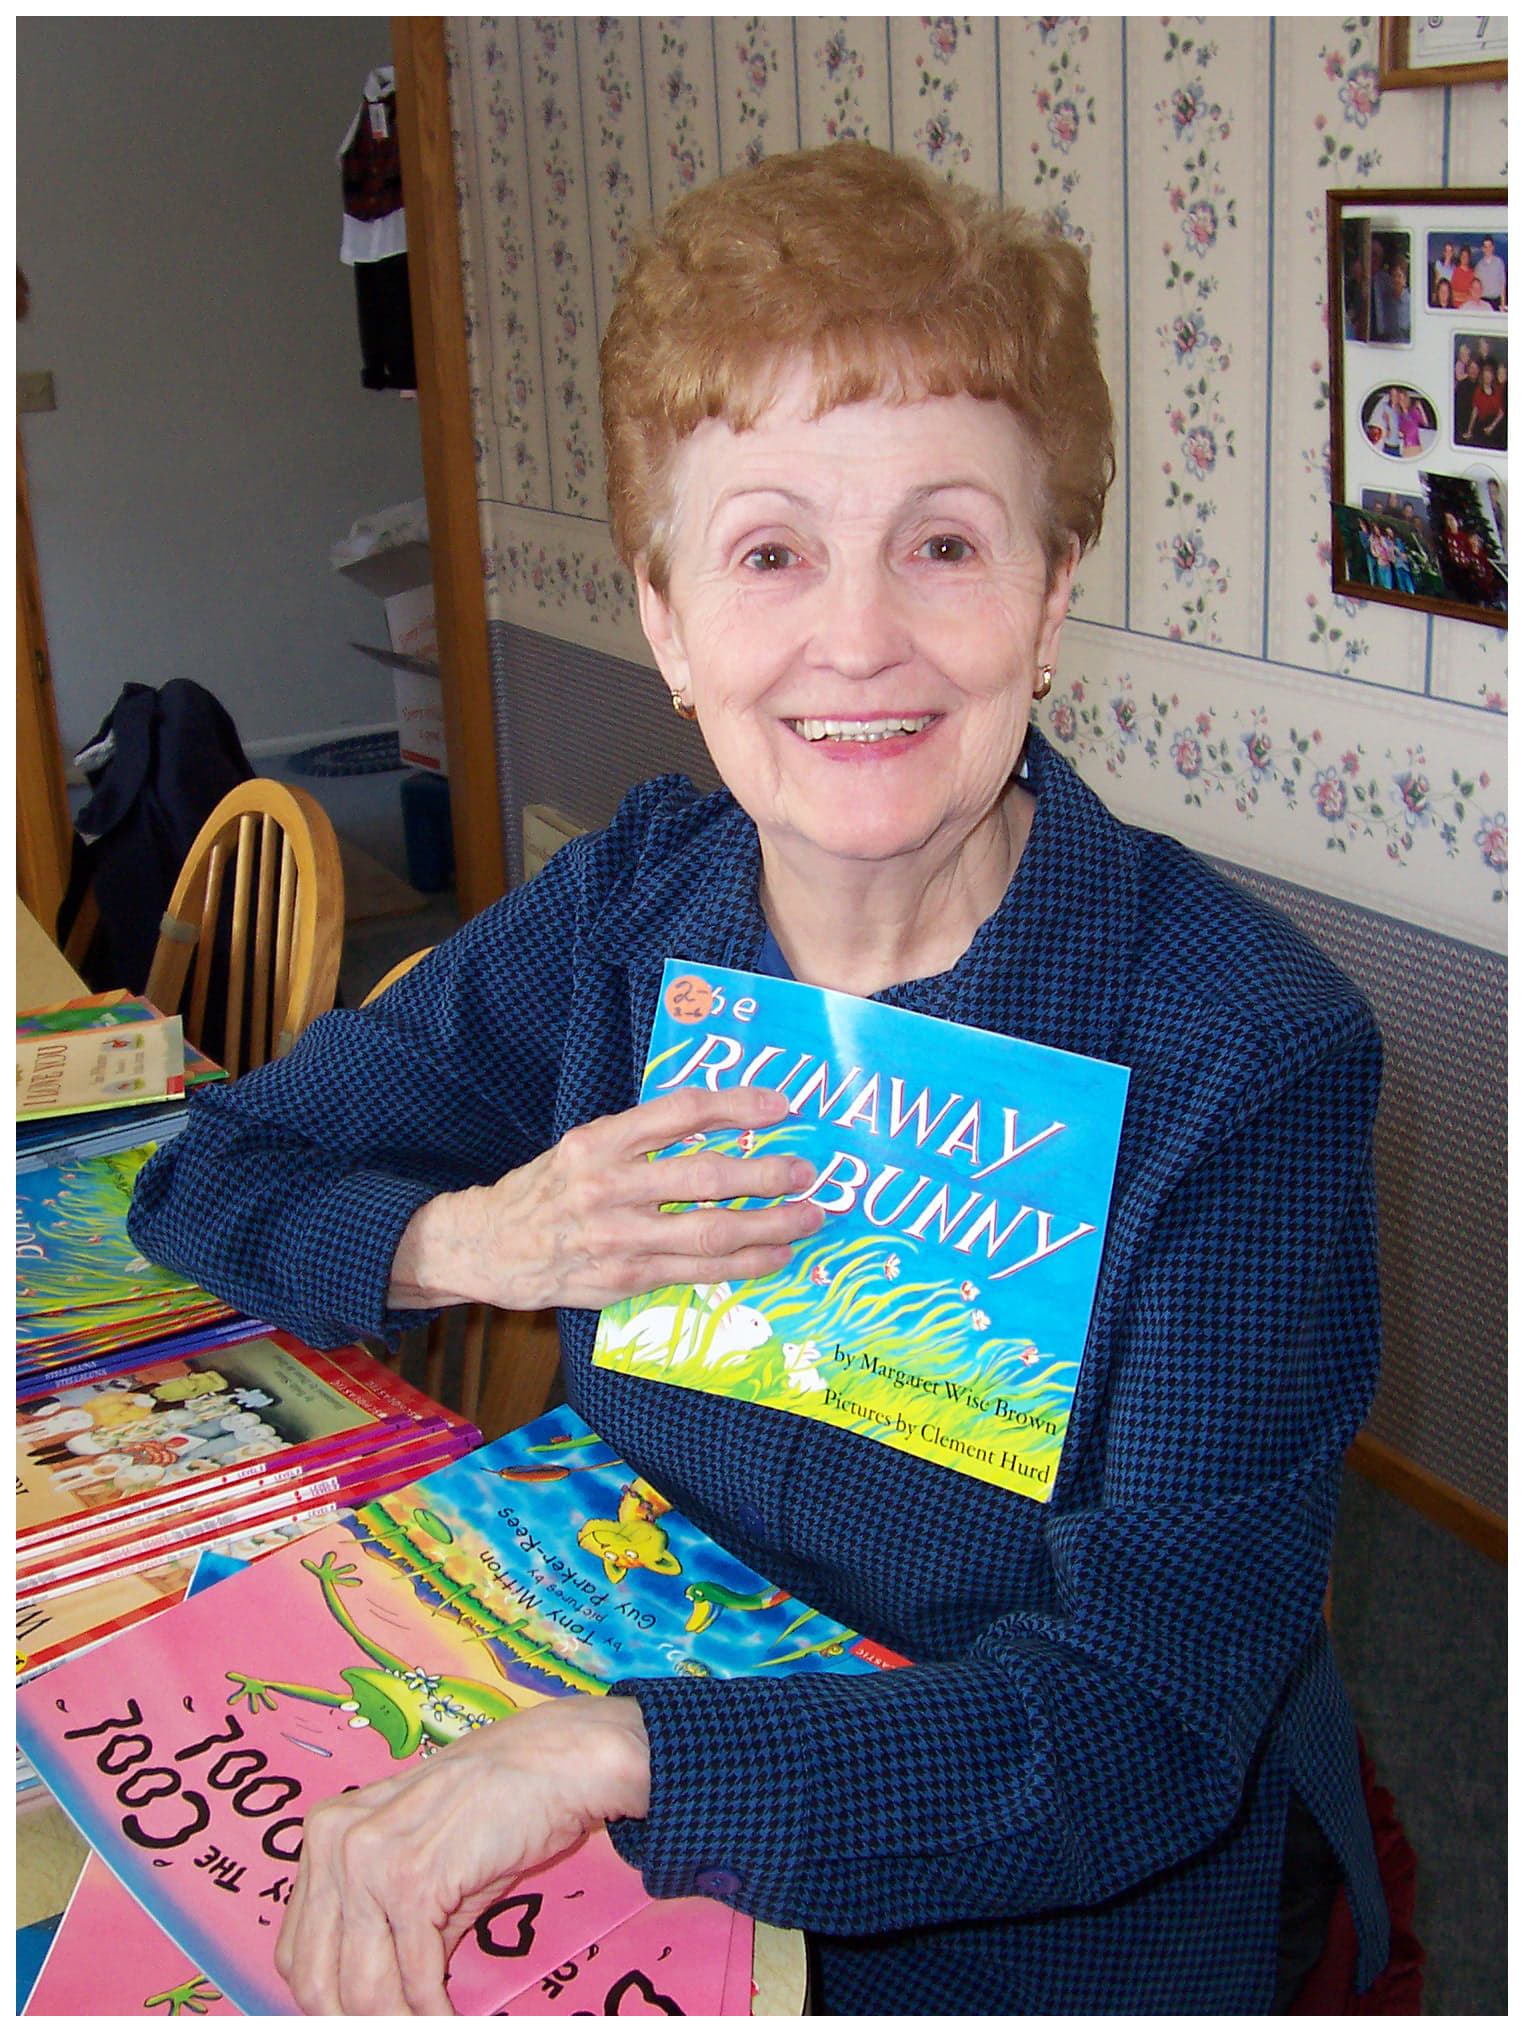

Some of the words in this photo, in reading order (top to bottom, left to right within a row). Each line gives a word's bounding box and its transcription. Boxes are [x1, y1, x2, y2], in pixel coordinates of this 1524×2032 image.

[710, 986, 759, 1022] he
[33, 1045, 68, 1073] YOU
[26, 1071, 62, 1099] LOVE
[656, 1033, 1067, 1180] RUNAWAY
[784, 1151, 1097, 1281] BUNNY
[834, 1344, 856, 1370] by
[860, 1353, 940, 1394] Margaret
[945, 1380, 990, 1413] Wise
[995, 1399, 1057, 1436] Brown
[824, 1388, 892, 1427] Pictures
[895, 1412, 917, 1440] by
[921, 1423, 996, 1464] Clement
[1000, 1451, 1051, 1484] Hurd
[498, 1507, 609, 1606] Parker-Rees
[527, 1568, 545, 1585] by
[479, 1550, 543, 1610] Mitton
[546, 1583, 608, 1623] pictures
[614, 1601, 656, 1630] Guy
[545, 1609, 596, 1646] Tony
[604, 1636, 622, 1652] by
[64, 1699, 210, 1849] COOL
[193, 1845, 248, 1893] THE
[258, 1876, 295, 1905] Y
